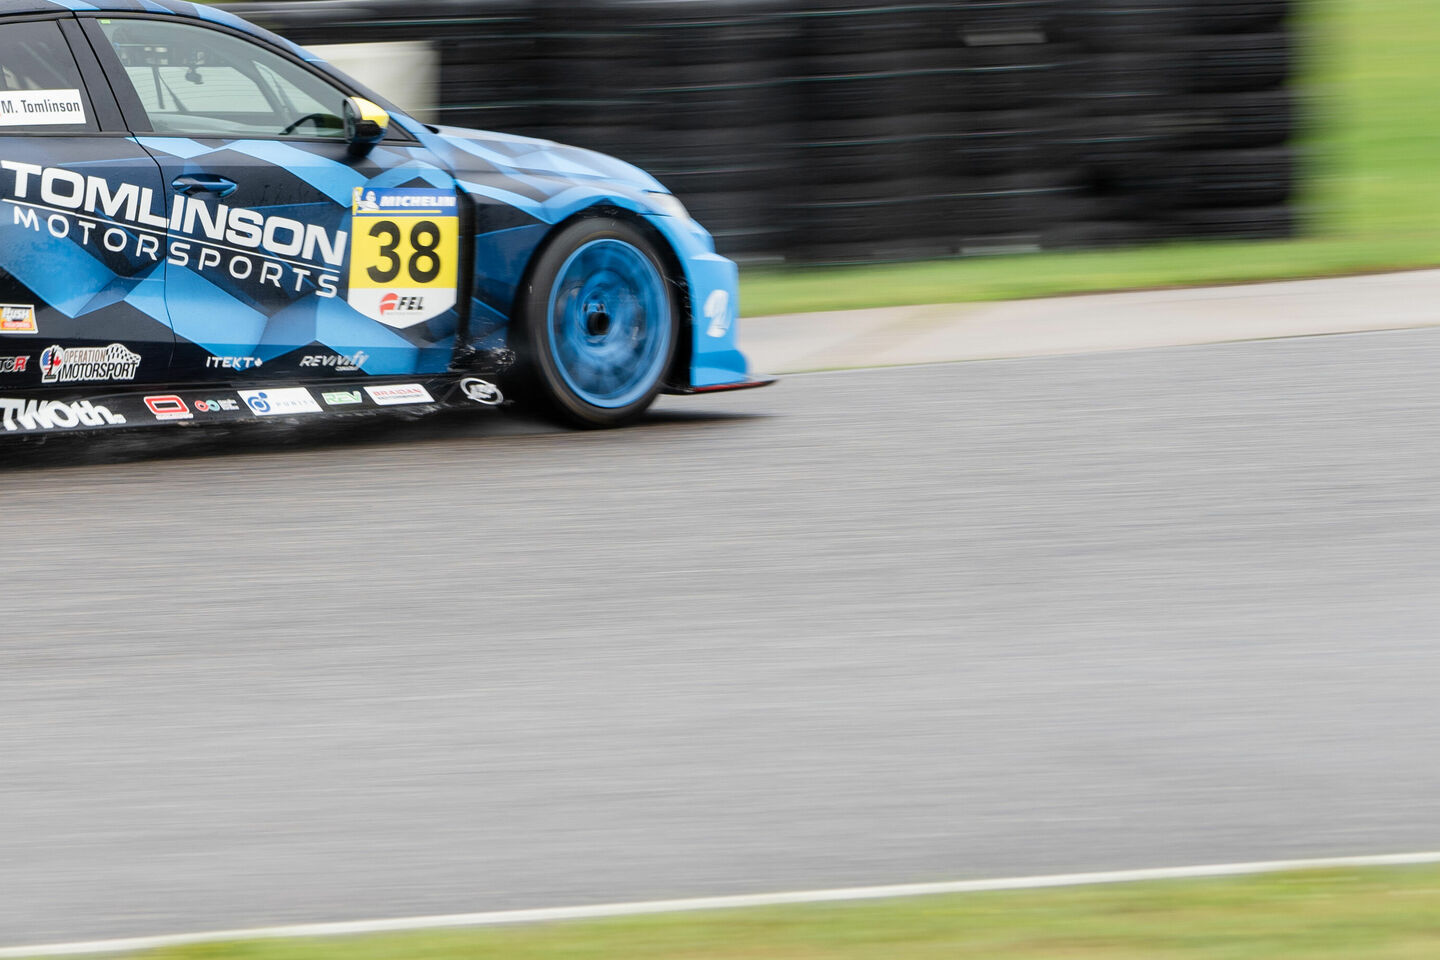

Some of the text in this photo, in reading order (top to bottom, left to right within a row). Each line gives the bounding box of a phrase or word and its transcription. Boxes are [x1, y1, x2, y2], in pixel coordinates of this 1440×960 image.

[1, 98, 81, 114] M. Tomlinson
[379, 195, 457, 207] MICHELIN
[0, 159, 348, 267] TOMLINSON
[13, 205, 340, 299] MOTORSPORTS
[366, 220, 441, 284] 38
[63, 349, 106, 364] OPERATION
[60, 362, 139, 380] MOTORSPORT
